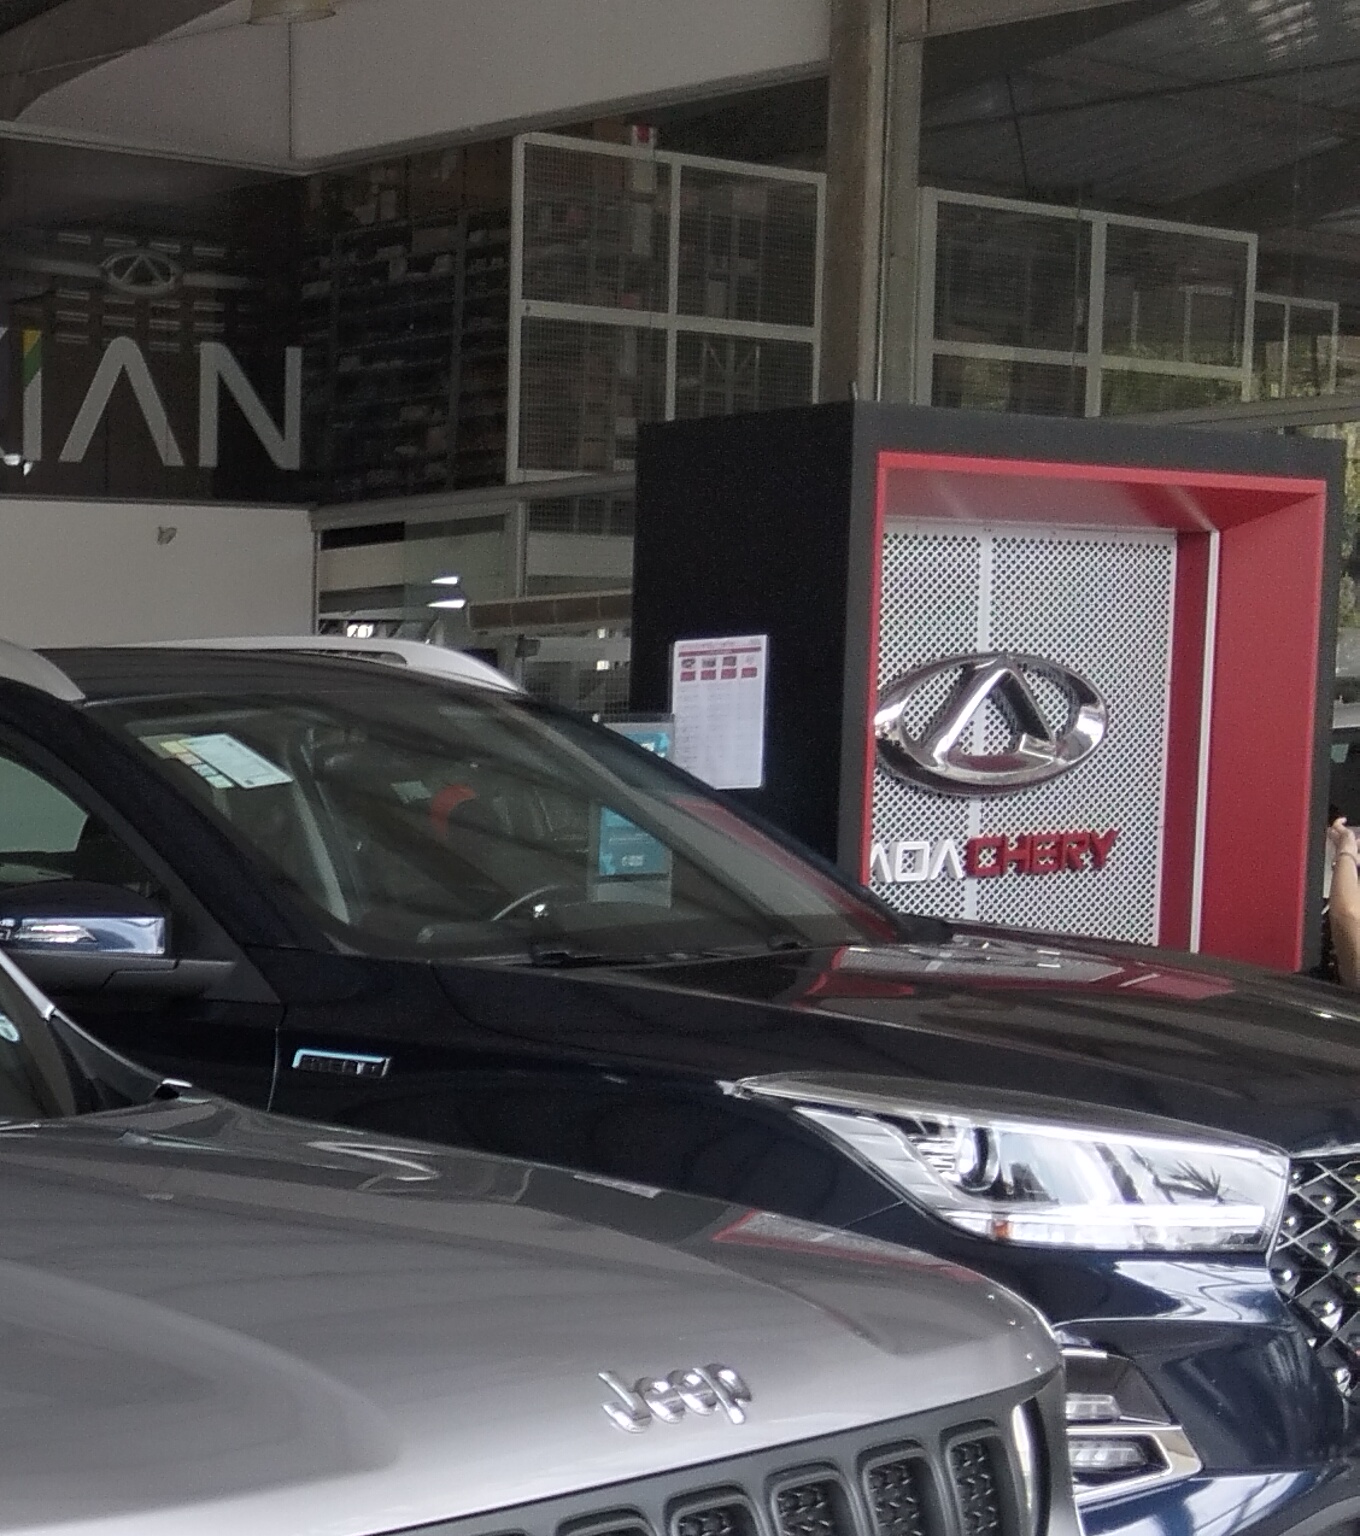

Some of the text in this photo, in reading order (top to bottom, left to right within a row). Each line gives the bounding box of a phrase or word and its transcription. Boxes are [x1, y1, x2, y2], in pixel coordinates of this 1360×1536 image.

[870, 828, 1120, 883] AOA CHERY
[598, 1363, 752, 1434] Jeep
